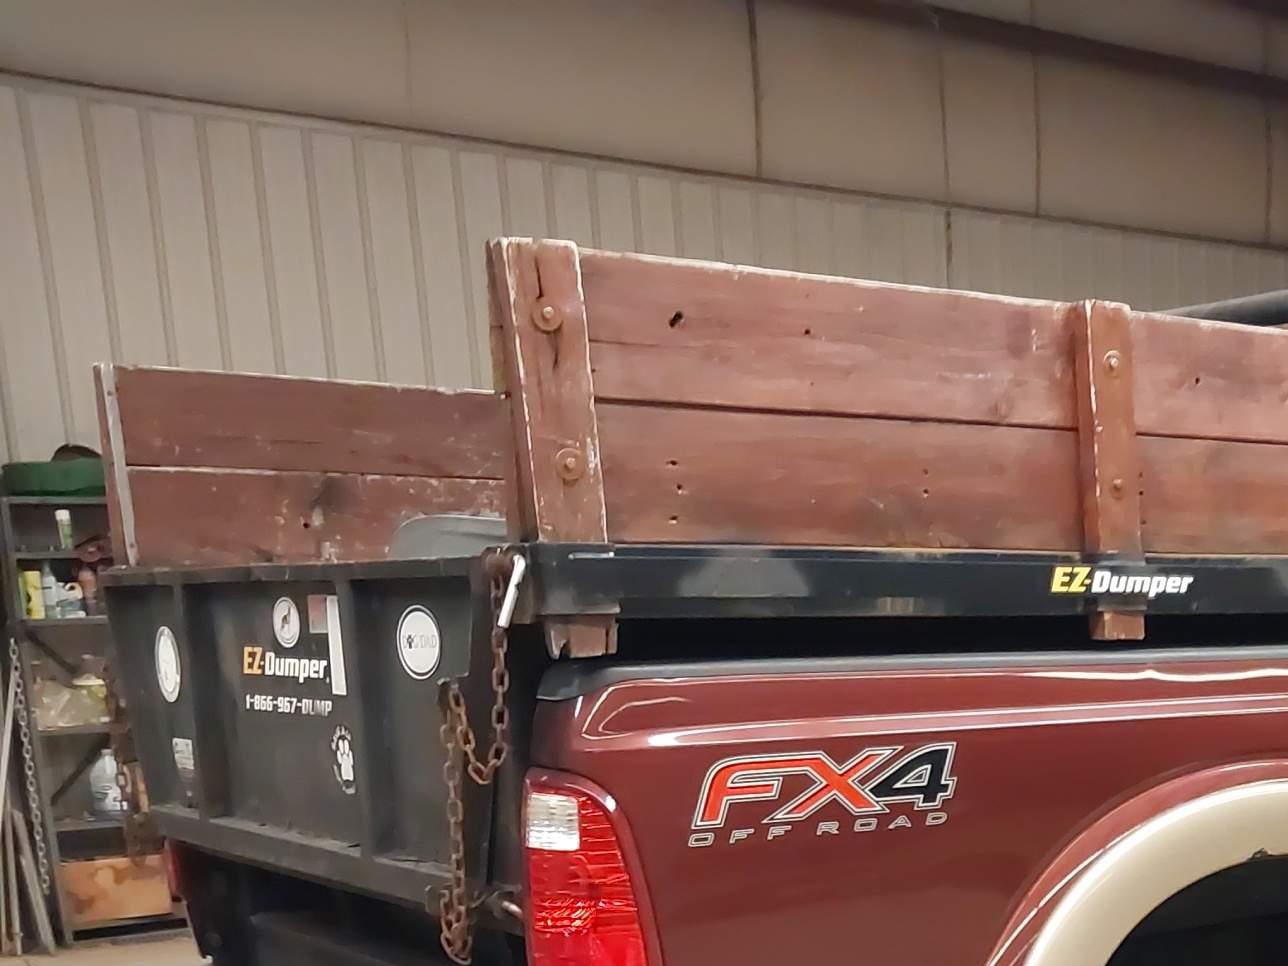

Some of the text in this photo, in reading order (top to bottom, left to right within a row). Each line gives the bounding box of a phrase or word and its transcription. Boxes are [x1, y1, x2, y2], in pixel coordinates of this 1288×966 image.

[1051, 566, 1194, 598] EZ-Dumper
[243, 646, 328, 684] EZ-Dumper
[691, 741, 957, 829] FX4
